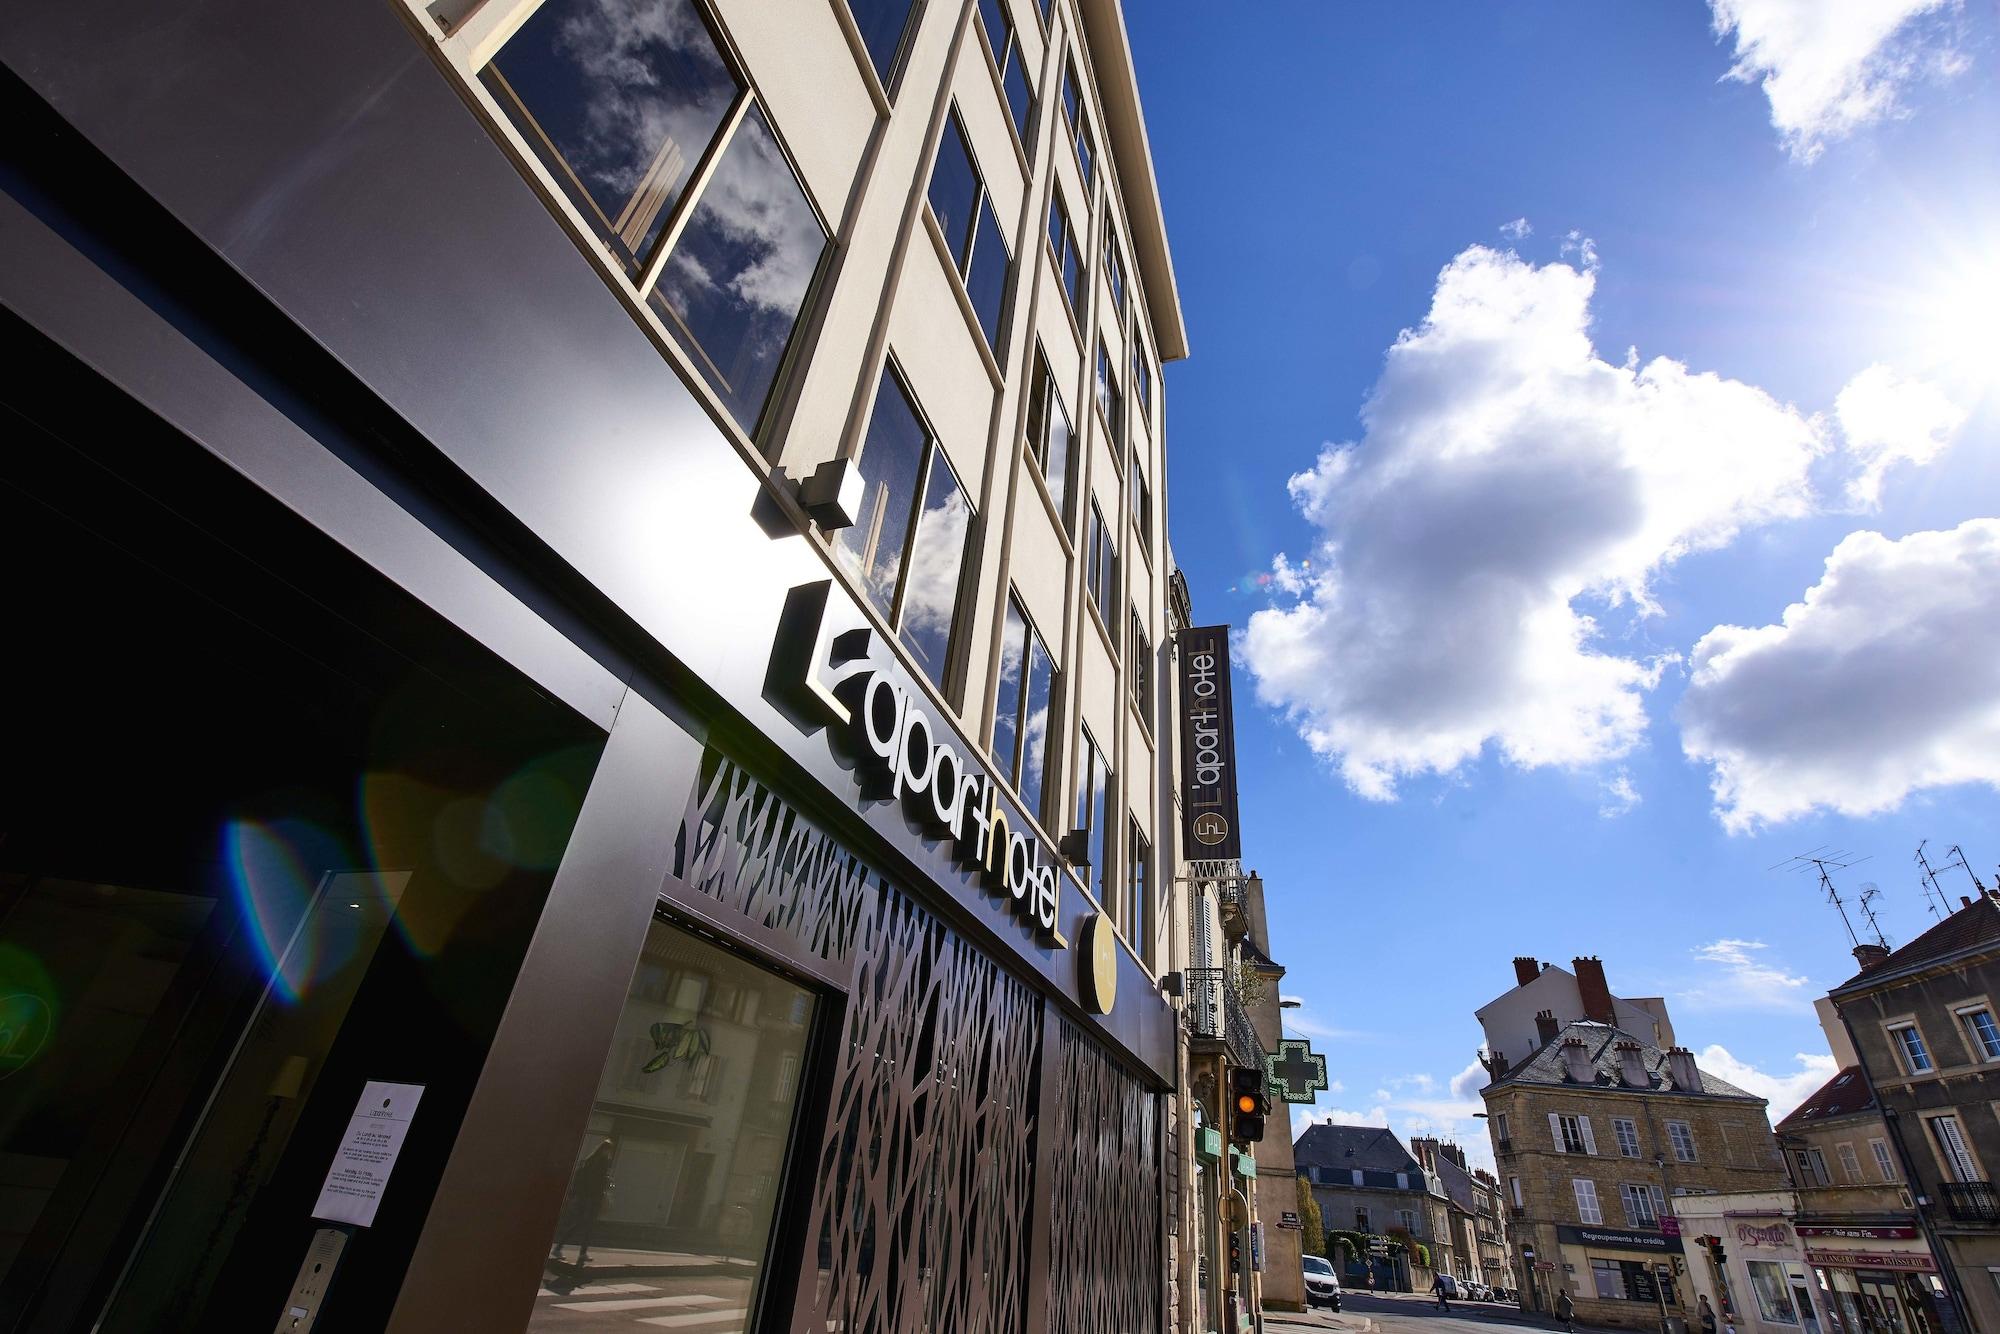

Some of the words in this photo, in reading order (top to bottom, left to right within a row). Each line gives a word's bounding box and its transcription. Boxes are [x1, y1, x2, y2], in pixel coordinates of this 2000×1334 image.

[1582, 1231, 1633, 1243] Regroupements
[1643, 1237, 1665, 1246] crédits
[1812, 1253, 1856, 1264] BOULANGERIE
